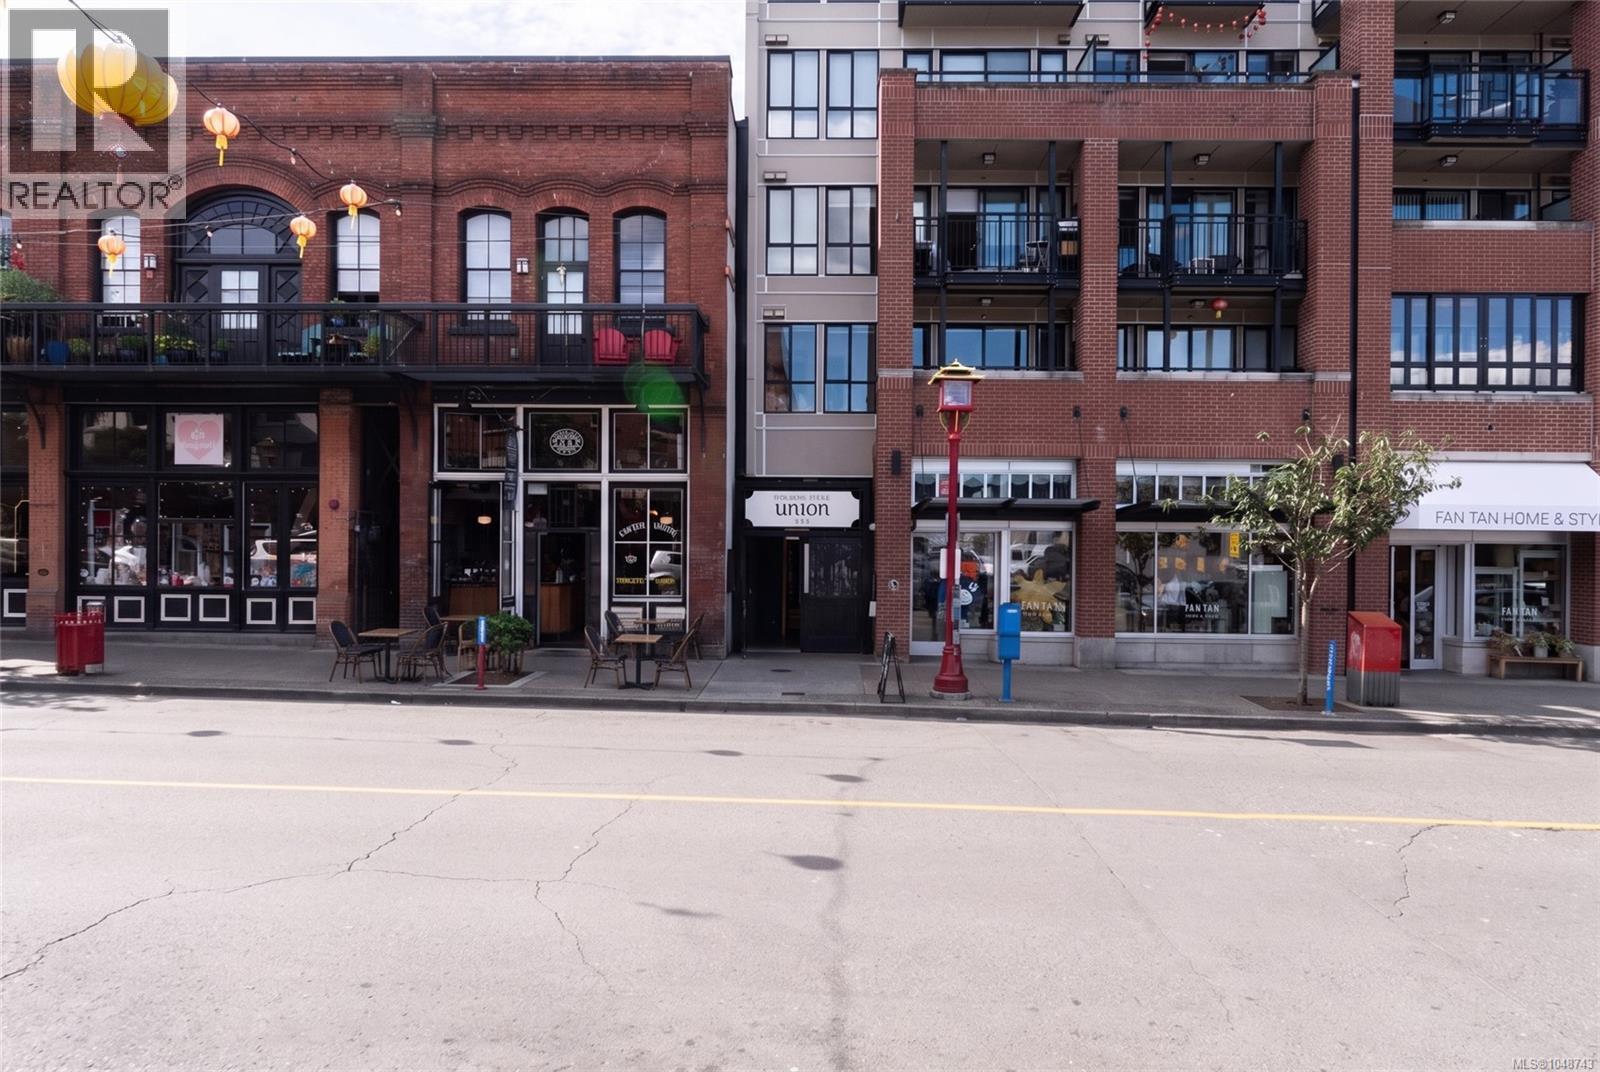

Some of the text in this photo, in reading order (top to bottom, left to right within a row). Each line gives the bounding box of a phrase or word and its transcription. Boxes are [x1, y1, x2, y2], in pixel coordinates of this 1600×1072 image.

[775, 503, 830, 516] union
[1435, 511, 1600, 526] FAN TAN HOME & STY
[1021, 600, 1040, 610] FAN
[1185, 603, 1220, 612] FAN TAN
[1501, 607, 1538, 617] FAN TAN
